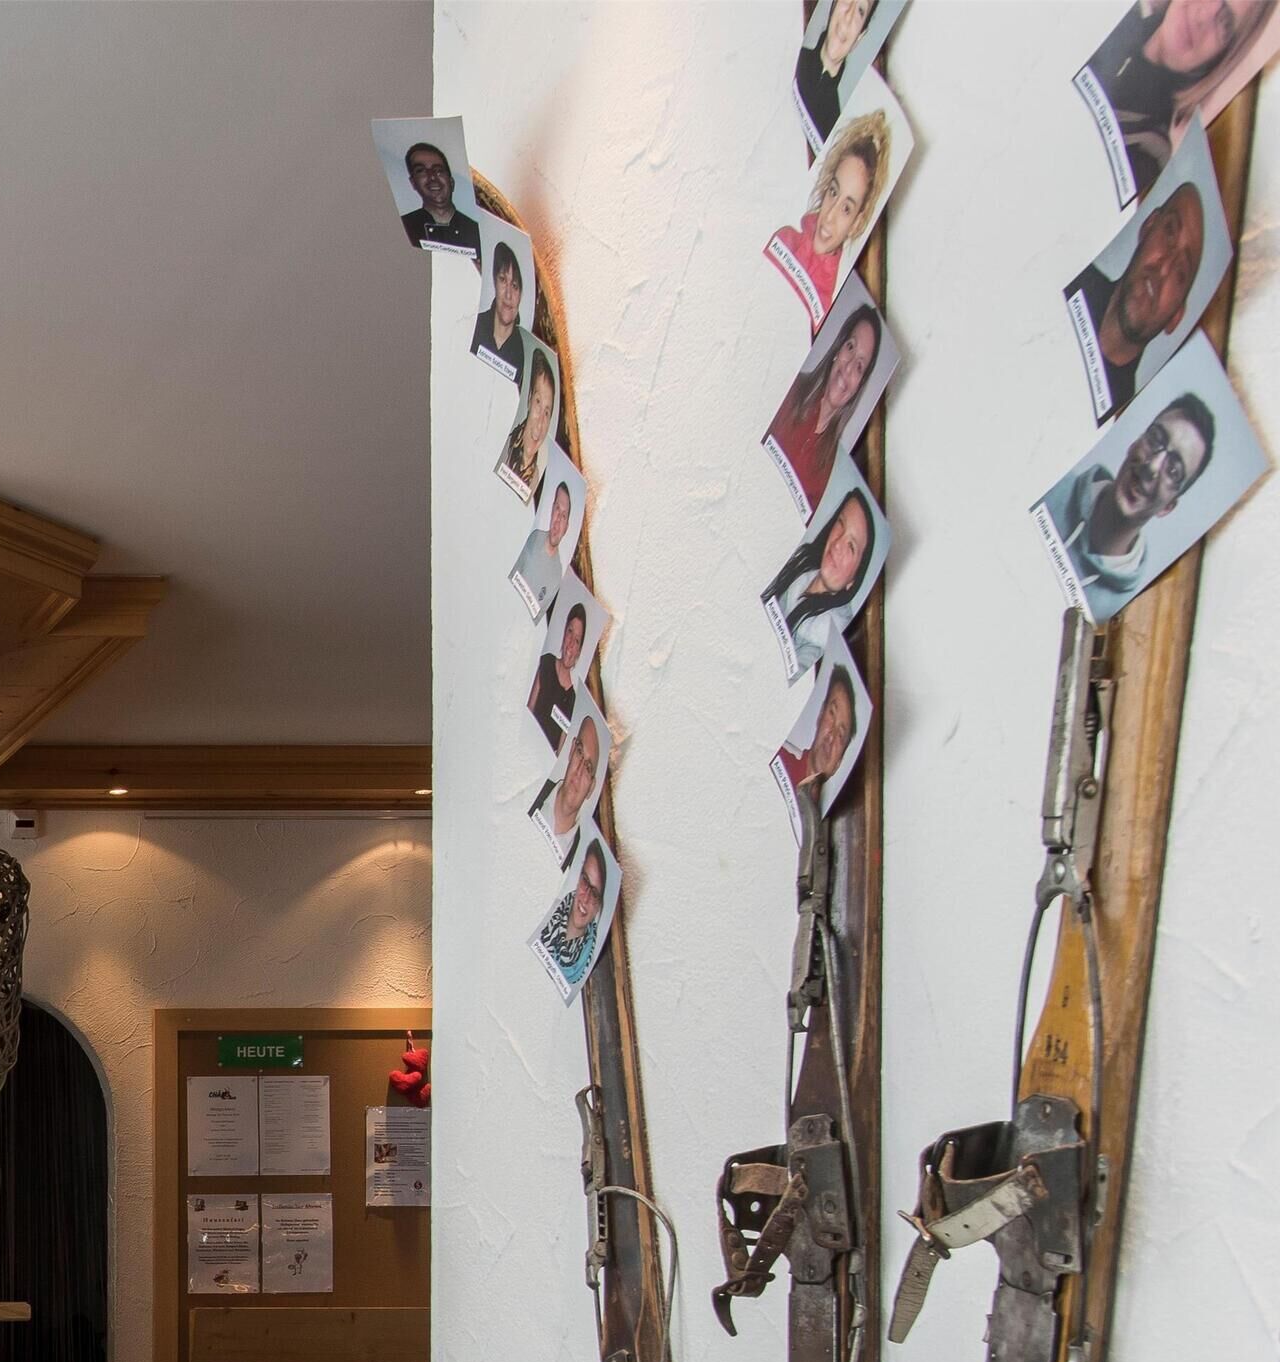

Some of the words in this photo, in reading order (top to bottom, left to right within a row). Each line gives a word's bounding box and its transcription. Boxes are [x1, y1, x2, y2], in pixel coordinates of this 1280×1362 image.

[772, 241, 784, 257] Ana
[766, 440, 783, 466] Patricia
[1035, 508, 1051, 541] Tobias
[236, 1046, 285, 1058] HEUTE
